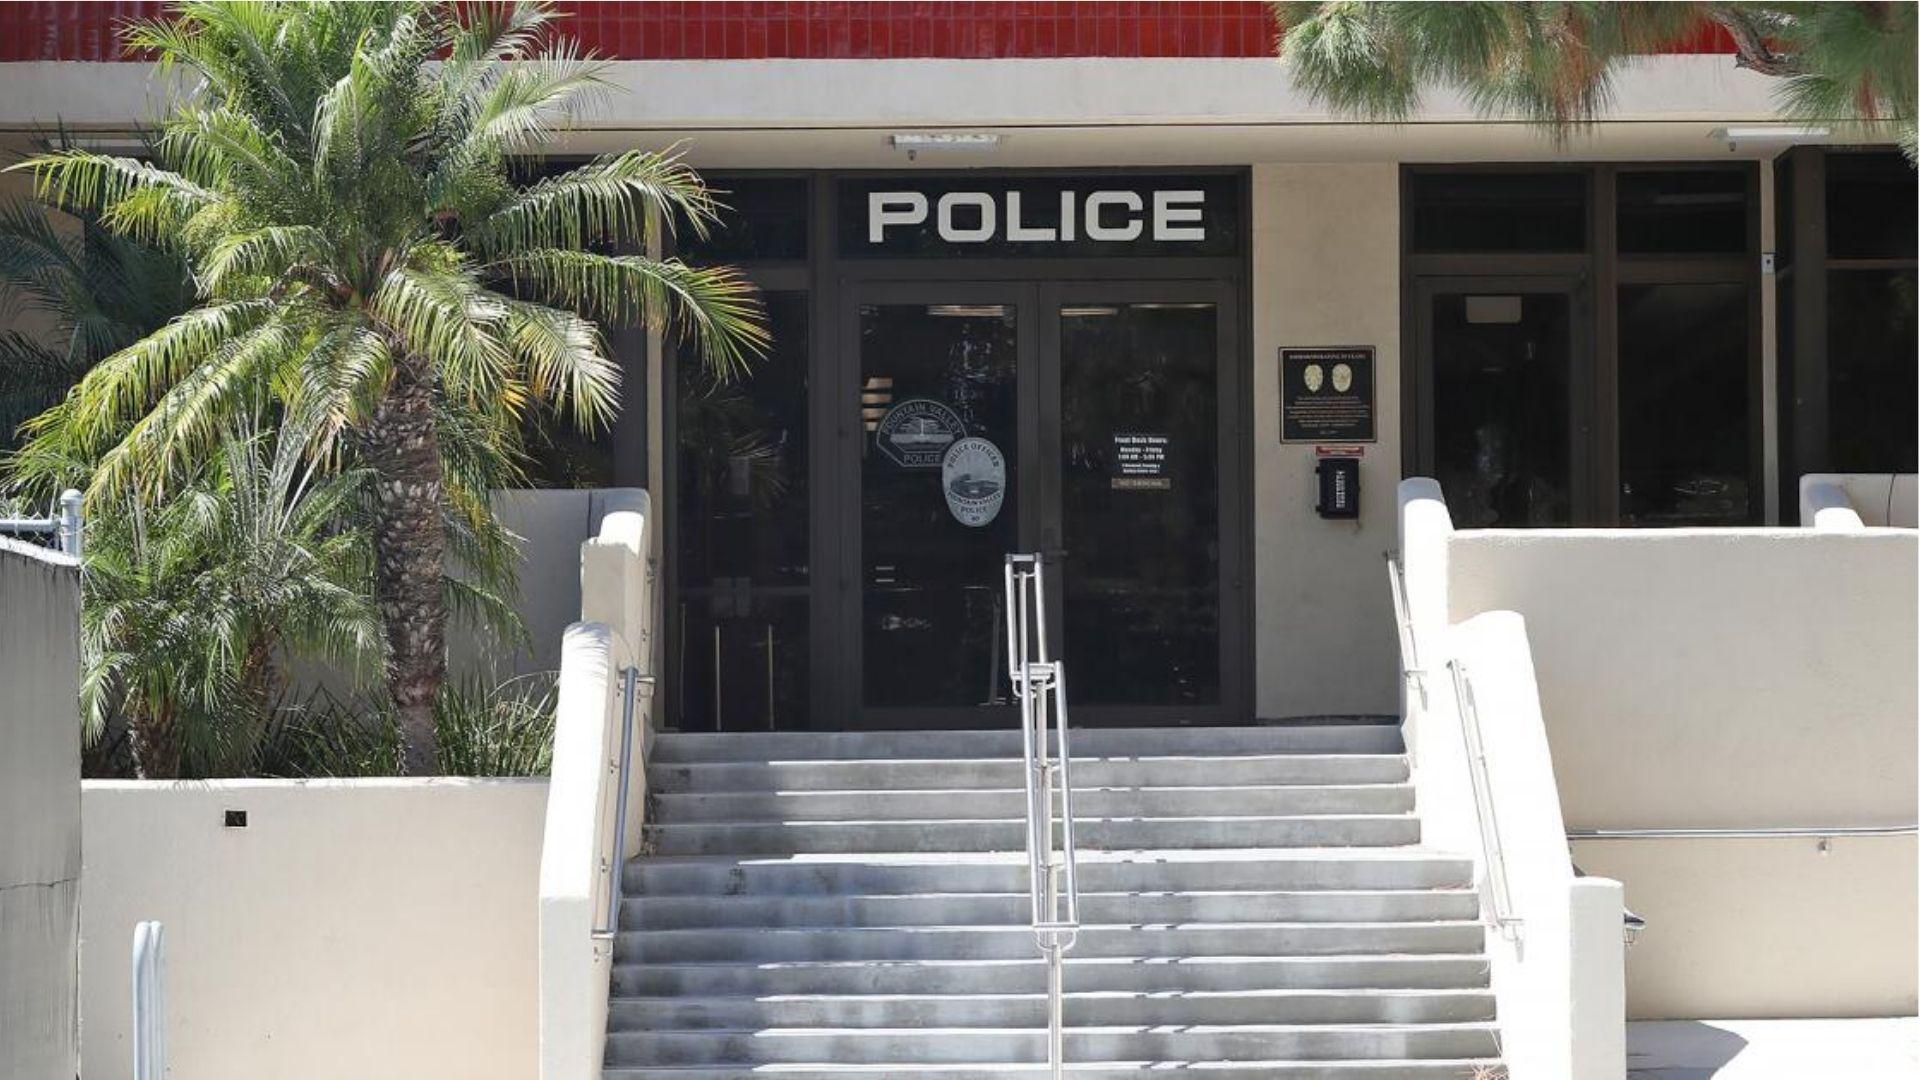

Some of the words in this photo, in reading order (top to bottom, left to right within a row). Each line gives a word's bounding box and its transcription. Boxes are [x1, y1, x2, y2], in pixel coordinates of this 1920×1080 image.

[868, 190, 1206, 243] POLICE
[903, 454, 940, 463] POLICE
[947, 444, 969, 468] POLICE
[970, 442, 1000, 468] OFFICER
